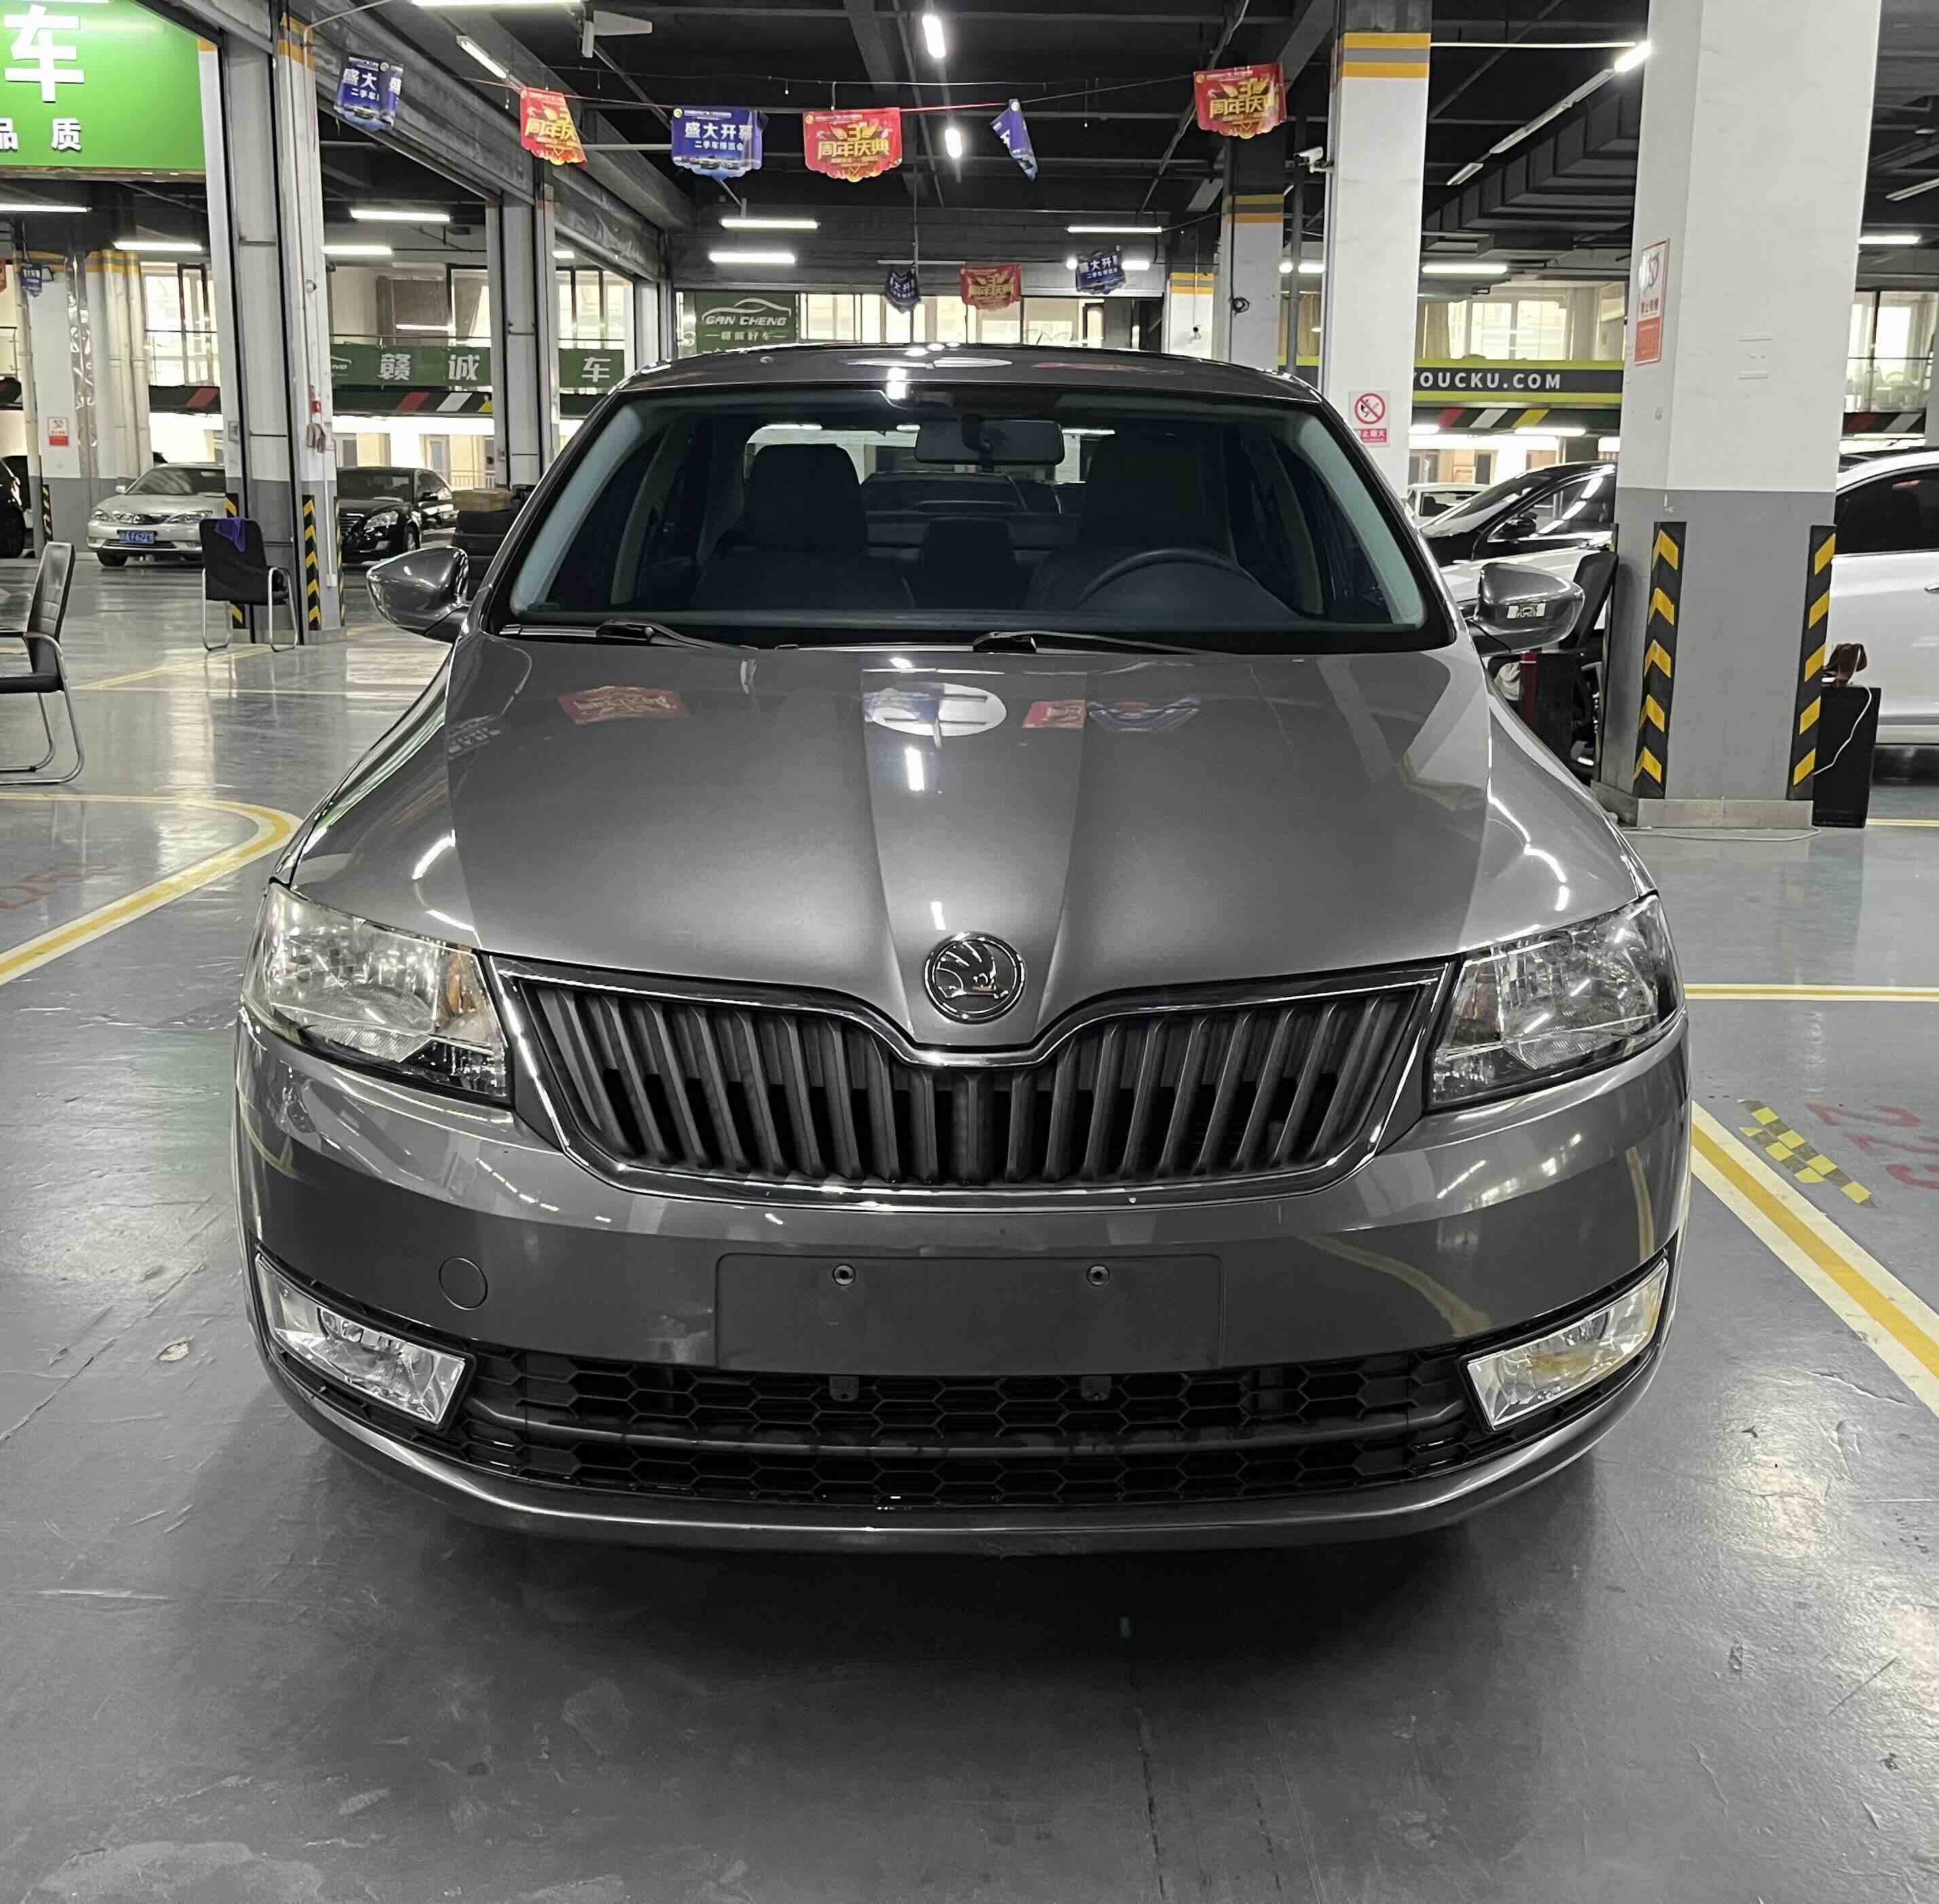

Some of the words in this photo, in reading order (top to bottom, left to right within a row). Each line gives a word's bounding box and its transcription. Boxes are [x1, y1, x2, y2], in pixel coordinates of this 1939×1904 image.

[3, 4, 85, 103] 车
[351, 88, 380, 101] 二手车
[0, 118, 82, 152] 品质
[684, 122, 753, 141] 盛大开幕
[817, 139, 889, 160] 周年庆典
[705, 315, 735, 325] GAN
[739, 316, 787, 327] CHENG
[376, 353, 480, 381] 赣诚
[582, 357, 611, 382] 车
